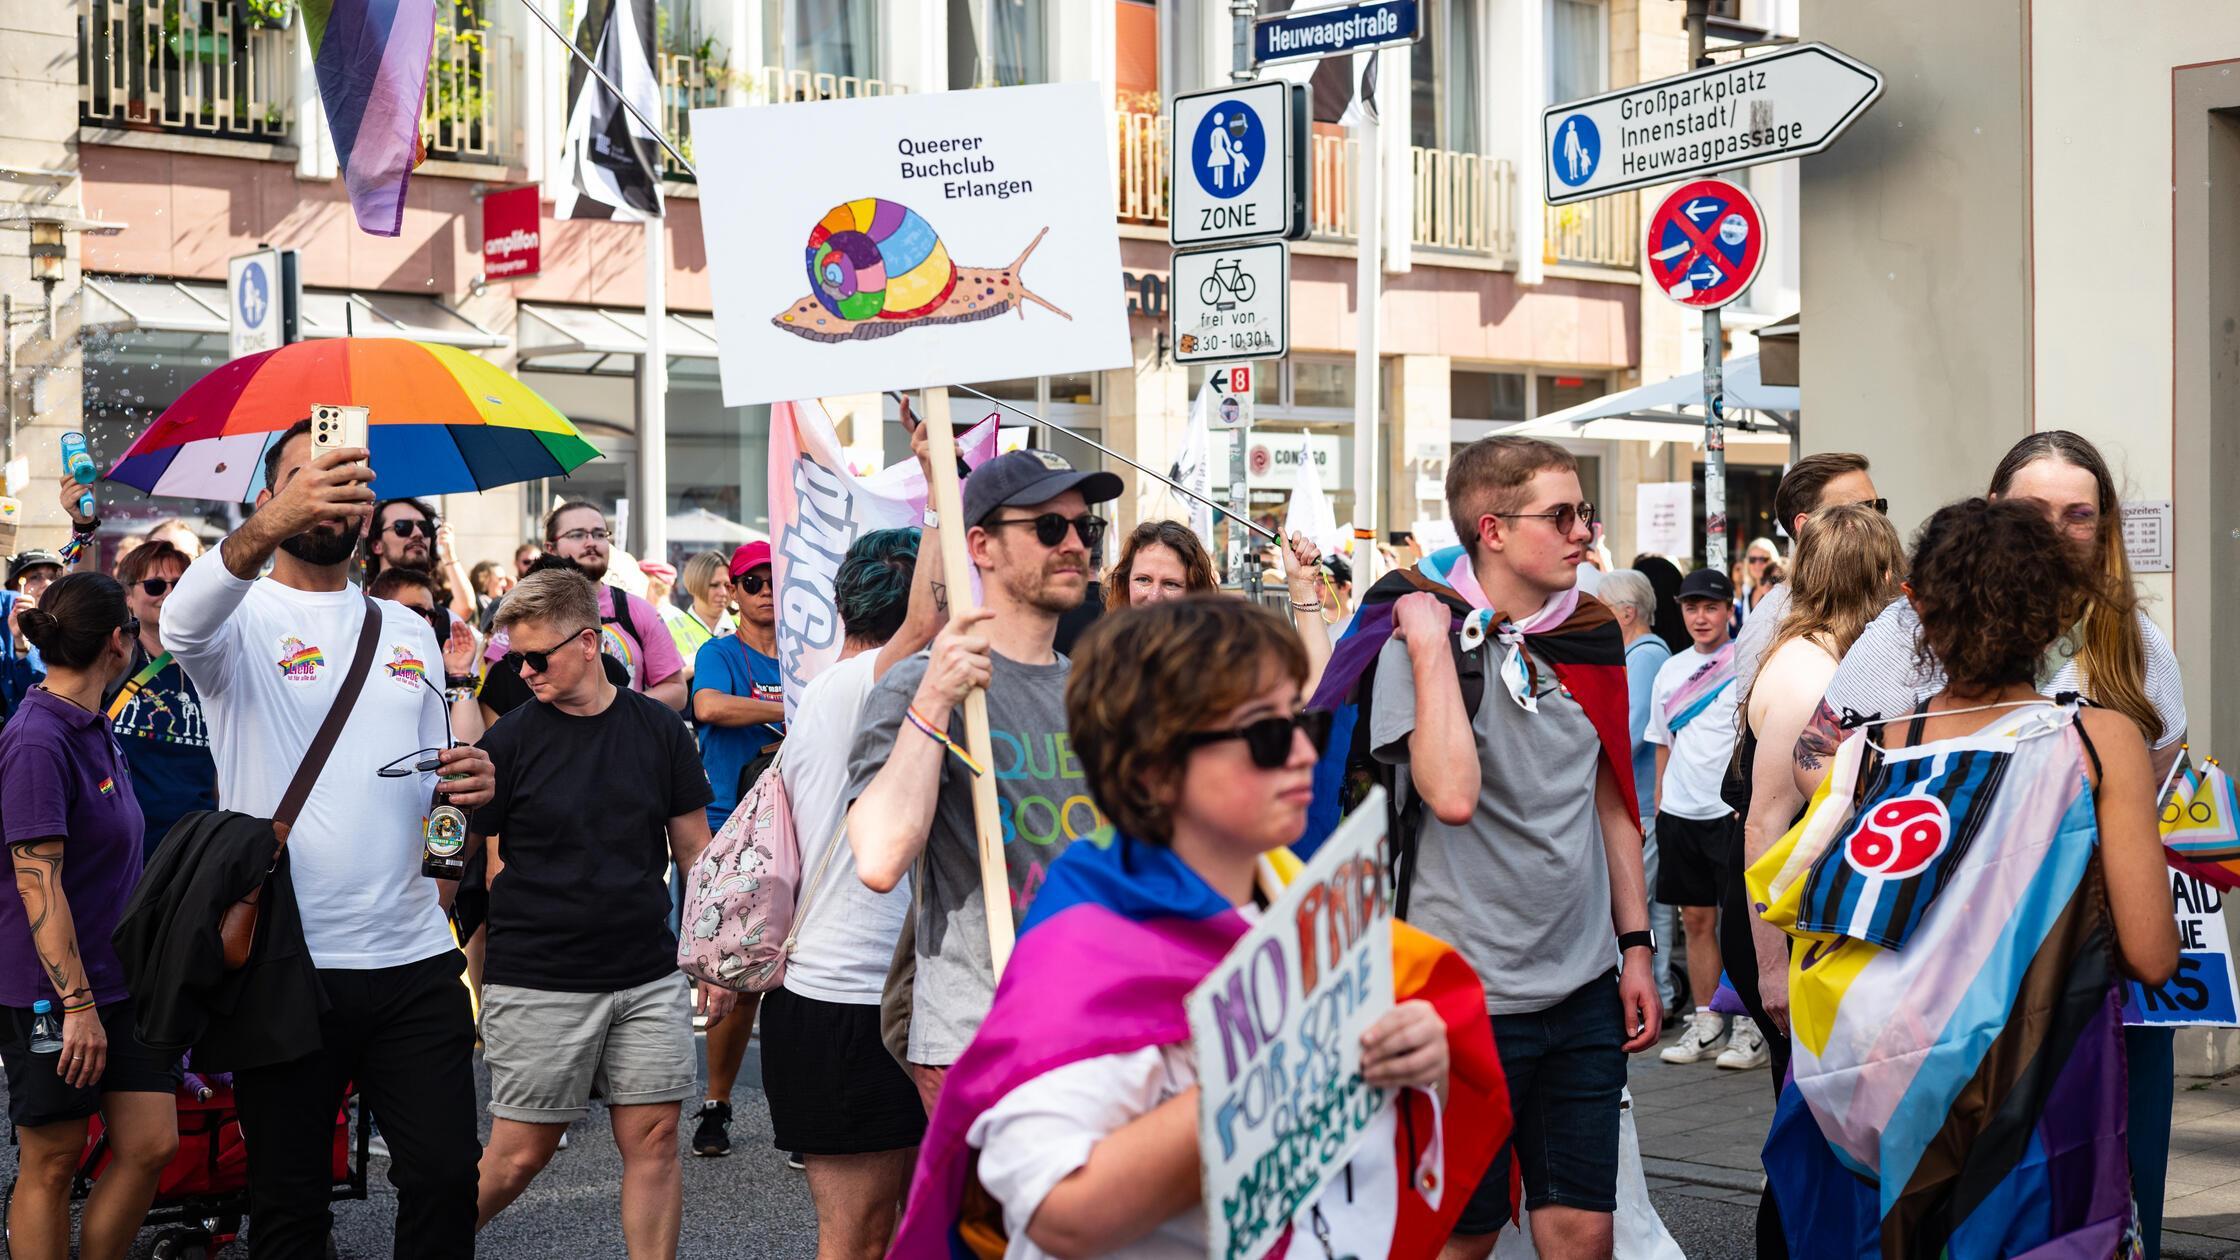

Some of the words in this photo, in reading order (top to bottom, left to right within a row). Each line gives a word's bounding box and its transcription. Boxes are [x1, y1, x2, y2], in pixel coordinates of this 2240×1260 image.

[1268, 7, 1398, 52] Heuwaagstraße
[1621, 70, 1767, 120] Großparkplatz
[1621, 99, 1738, 149] Innenstadt/
[898, 136, 983, 157] Queerer
[1622, 121, 1803, 176] Heuwaagpassage
[901, 155, 995, 179] Buchclub
[943, 179, 1033, 200] Erlangen
[1200, 203, 1257, 231] ZONE
[1201, 312, 1224, 328] frei
[1232, 311, 1256, 325] von
[1235, 369, 1246, 391] 8
[288, 662, 315, 675] Liebe
[113, 725, 133, 735] BE
[1210, 934, 1289, 1085] NO
[1215, 1037, 1289, 1163] FOR
